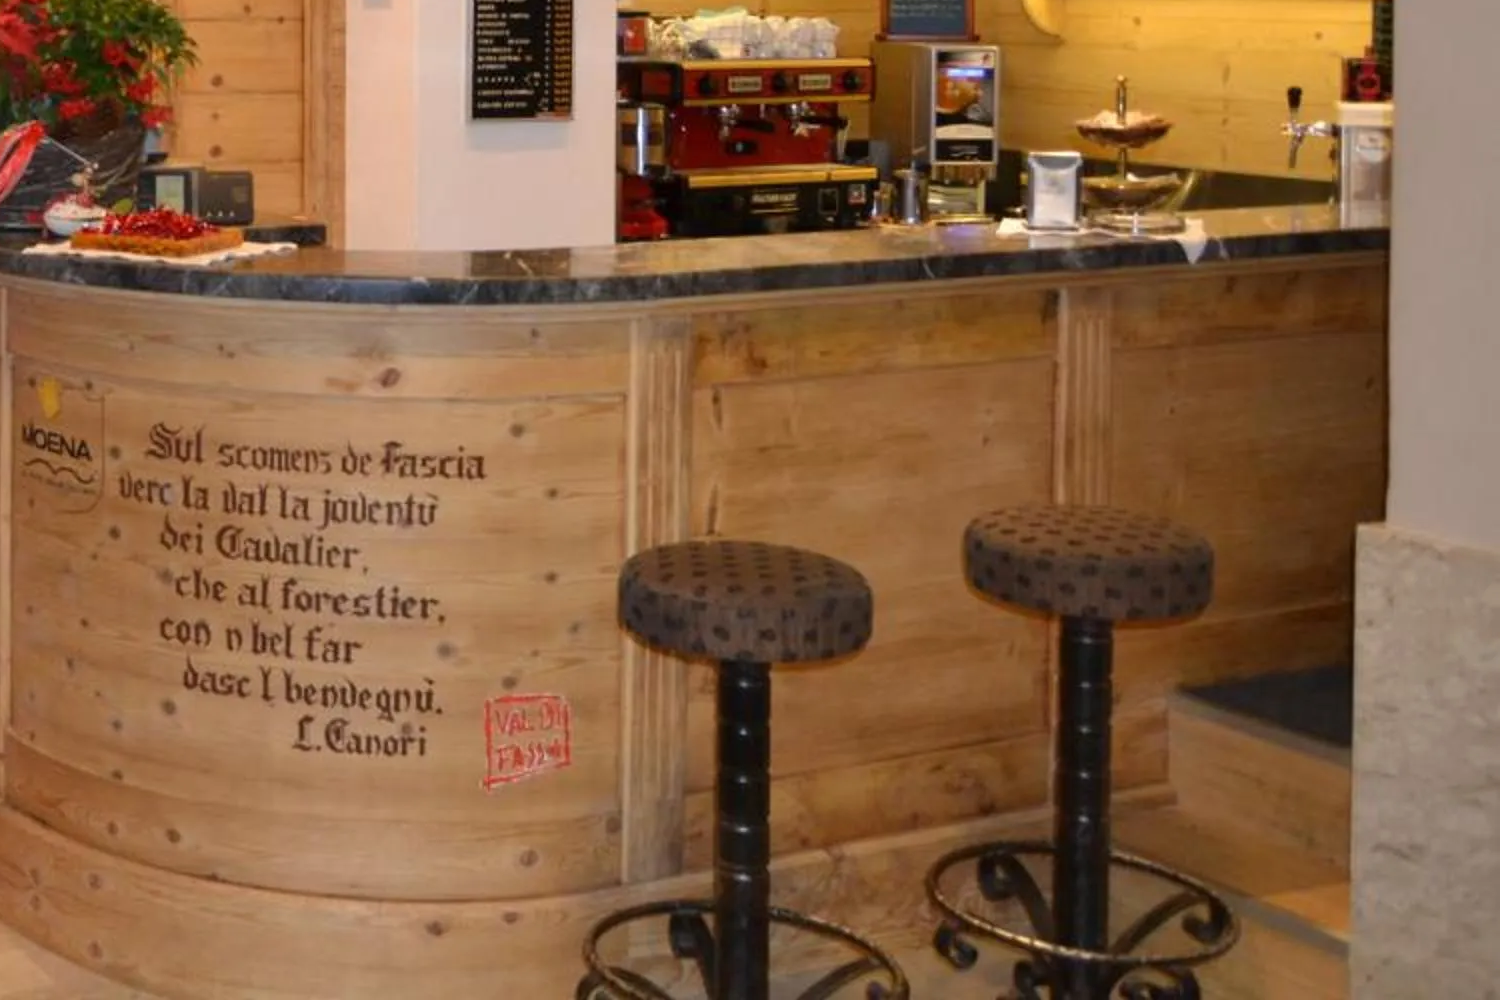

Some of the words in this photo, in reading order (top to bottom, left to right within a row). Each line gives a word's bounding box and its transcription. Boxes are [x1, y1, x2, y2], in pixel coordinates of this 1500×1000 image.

[145, 422, 206, 464] Sul
[340, 439, 373, 476] de
[380, 440, 488, 480] Fascia
[181, 474, 210, 511] la
[222, 480, 269, 515] val
[278, 485, 311, 521] la
[159, 513, 204, 554] dei
[175, 568, 227, 603] che
[238, 574, 270, 610] al
[159, 616, 211, 647] con
[250, 620, 295, 660] bel
[303, 625, 364, 665] far
